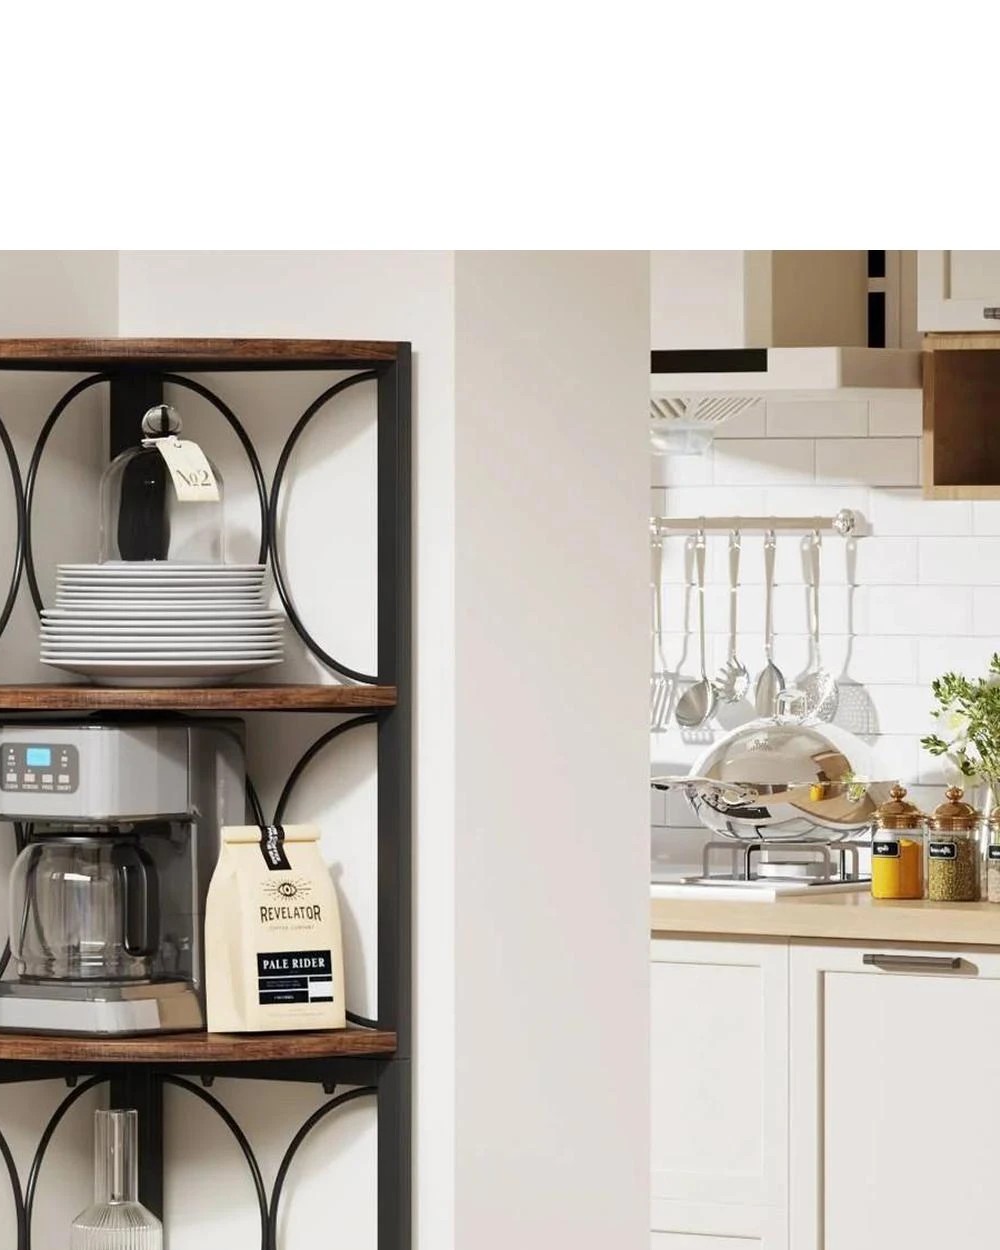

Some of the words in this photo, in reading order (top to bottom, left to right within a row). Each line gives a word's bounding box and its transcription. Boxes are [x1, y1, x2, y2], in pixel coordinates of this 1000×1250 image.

[260, 904, 321, 923] REVELATOR
[263, 960, 289, 970] PALE
[292, 957, 325, 969] RIDER
